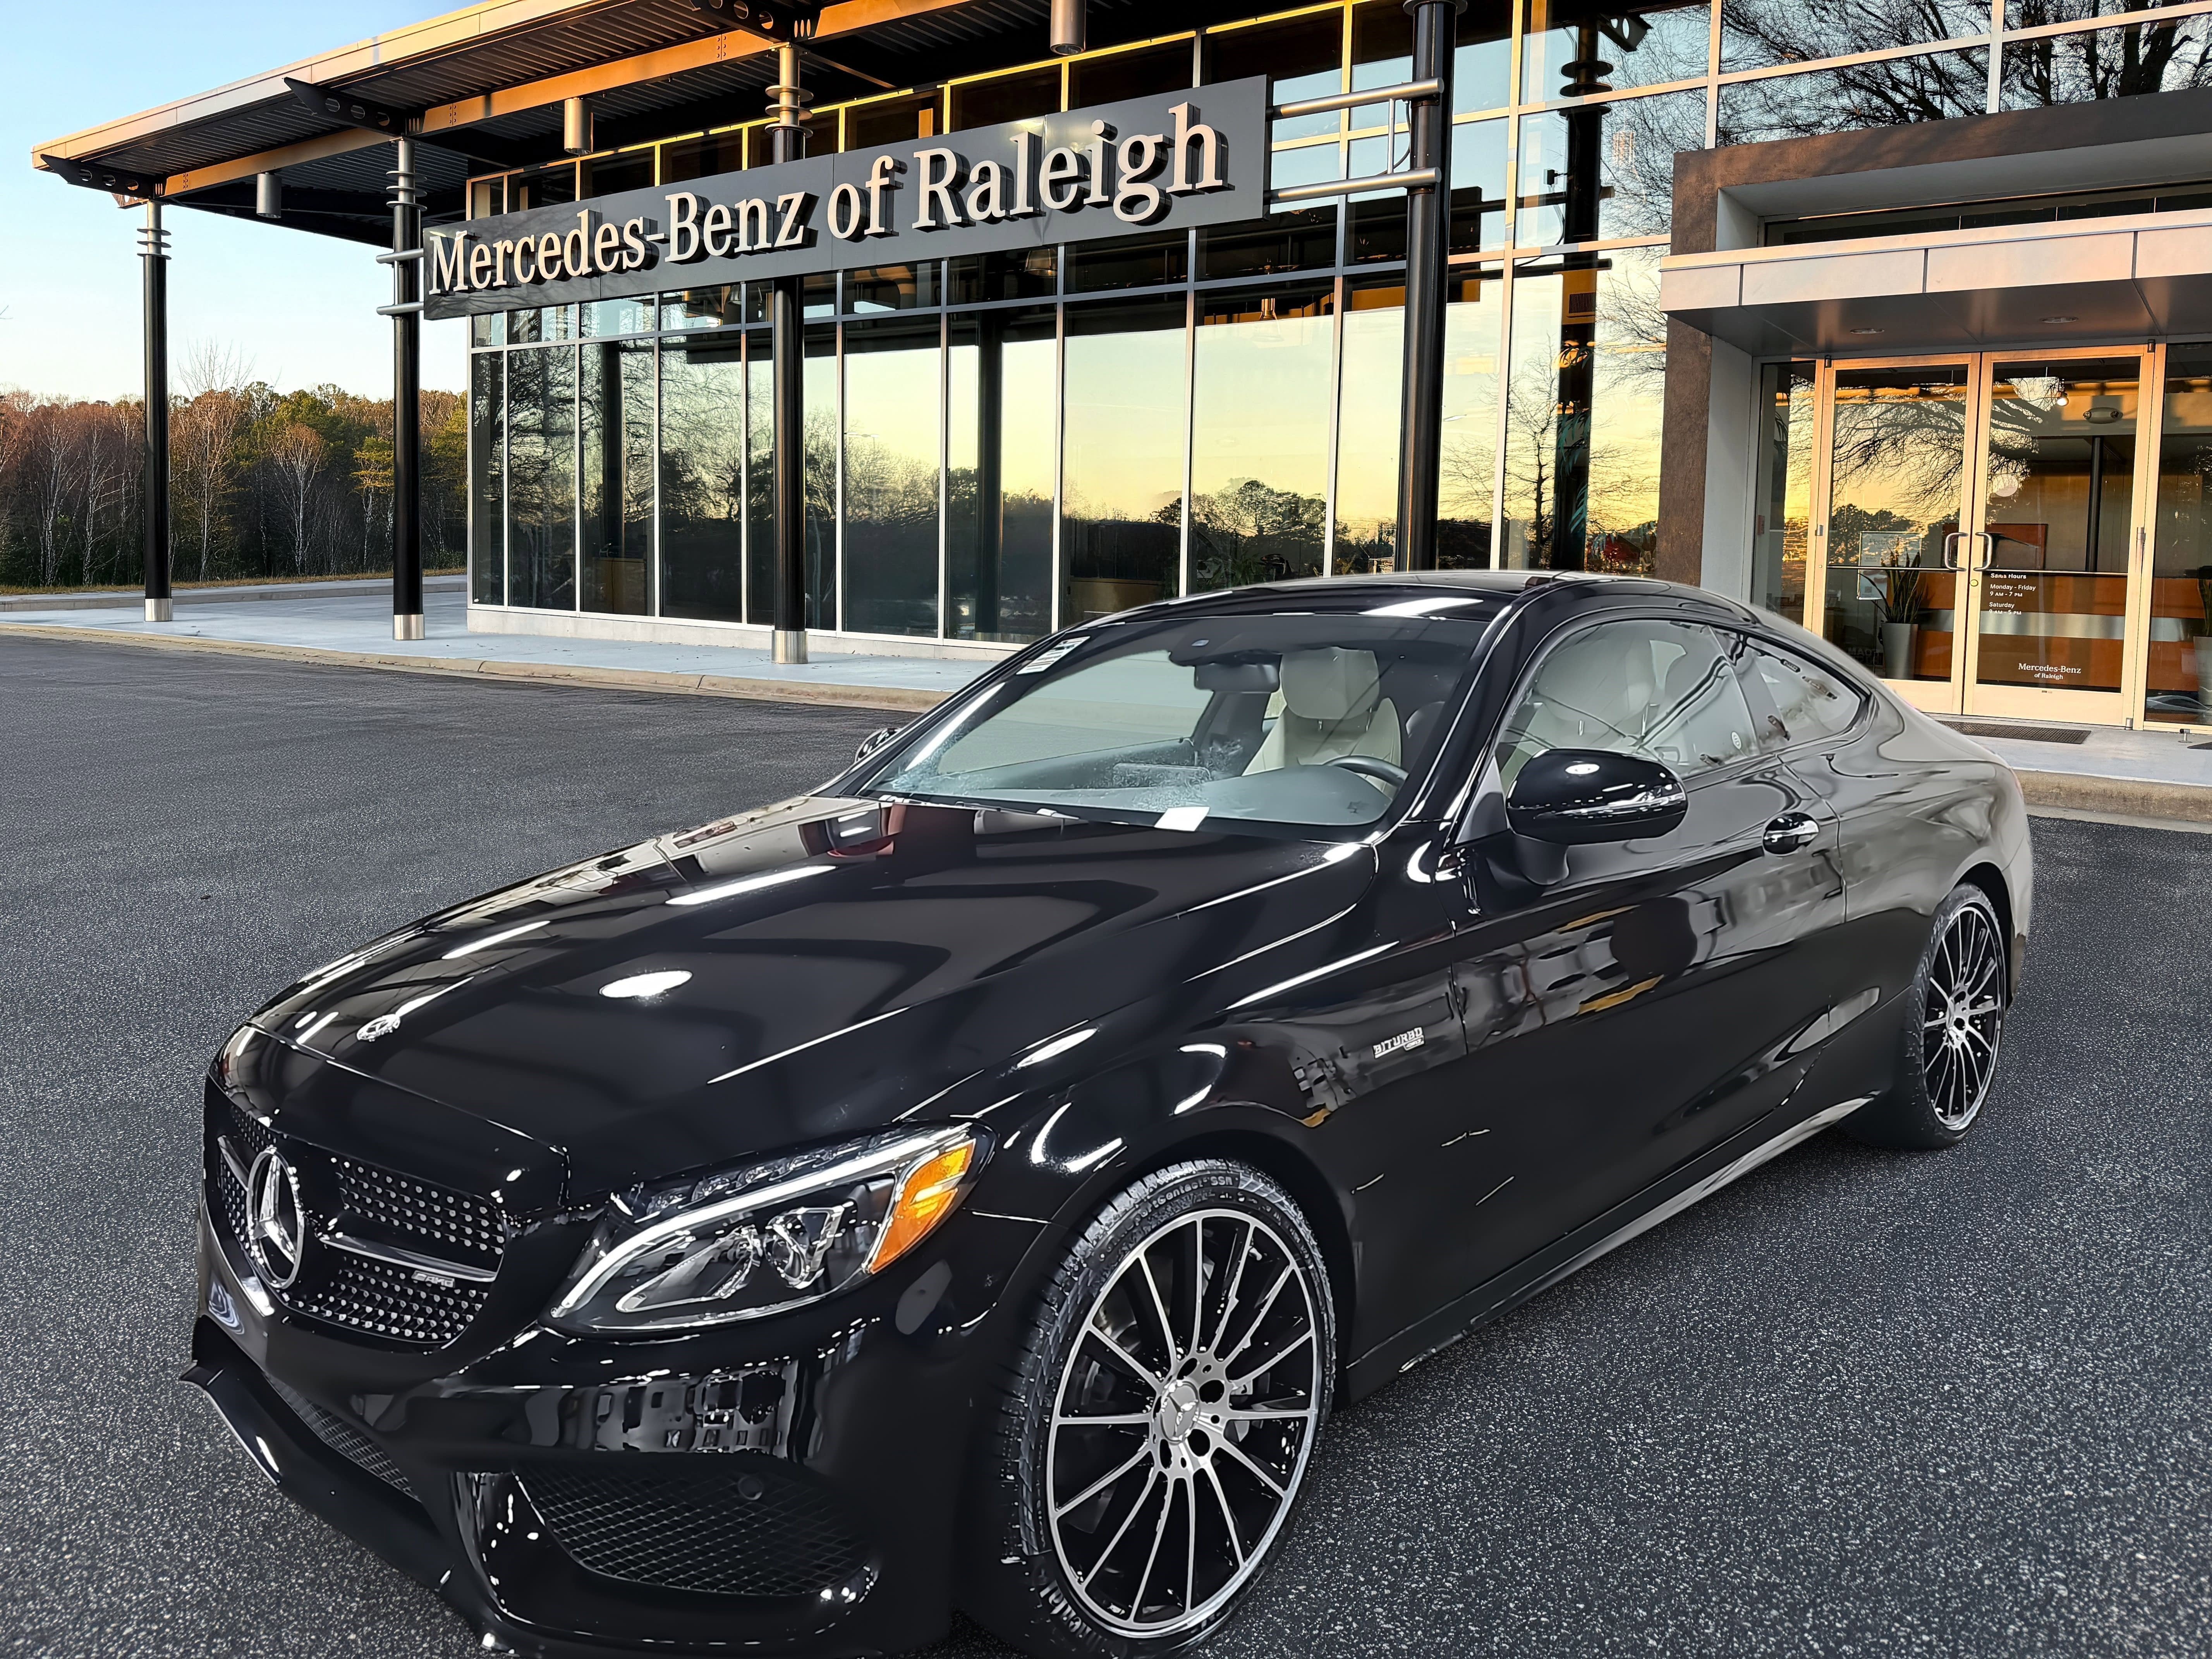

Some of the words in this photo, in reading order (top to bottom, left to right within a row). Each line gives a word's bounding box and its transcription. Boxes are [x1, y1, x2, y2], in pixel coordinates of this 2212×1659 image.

[429, 192, 805, 295] Mercedes-Benz
[827, 155, 894, 239] of
[912, 101, 1223, 223] Raleigh
[2018, 663, 2081, 674] Mercedes-Benz
